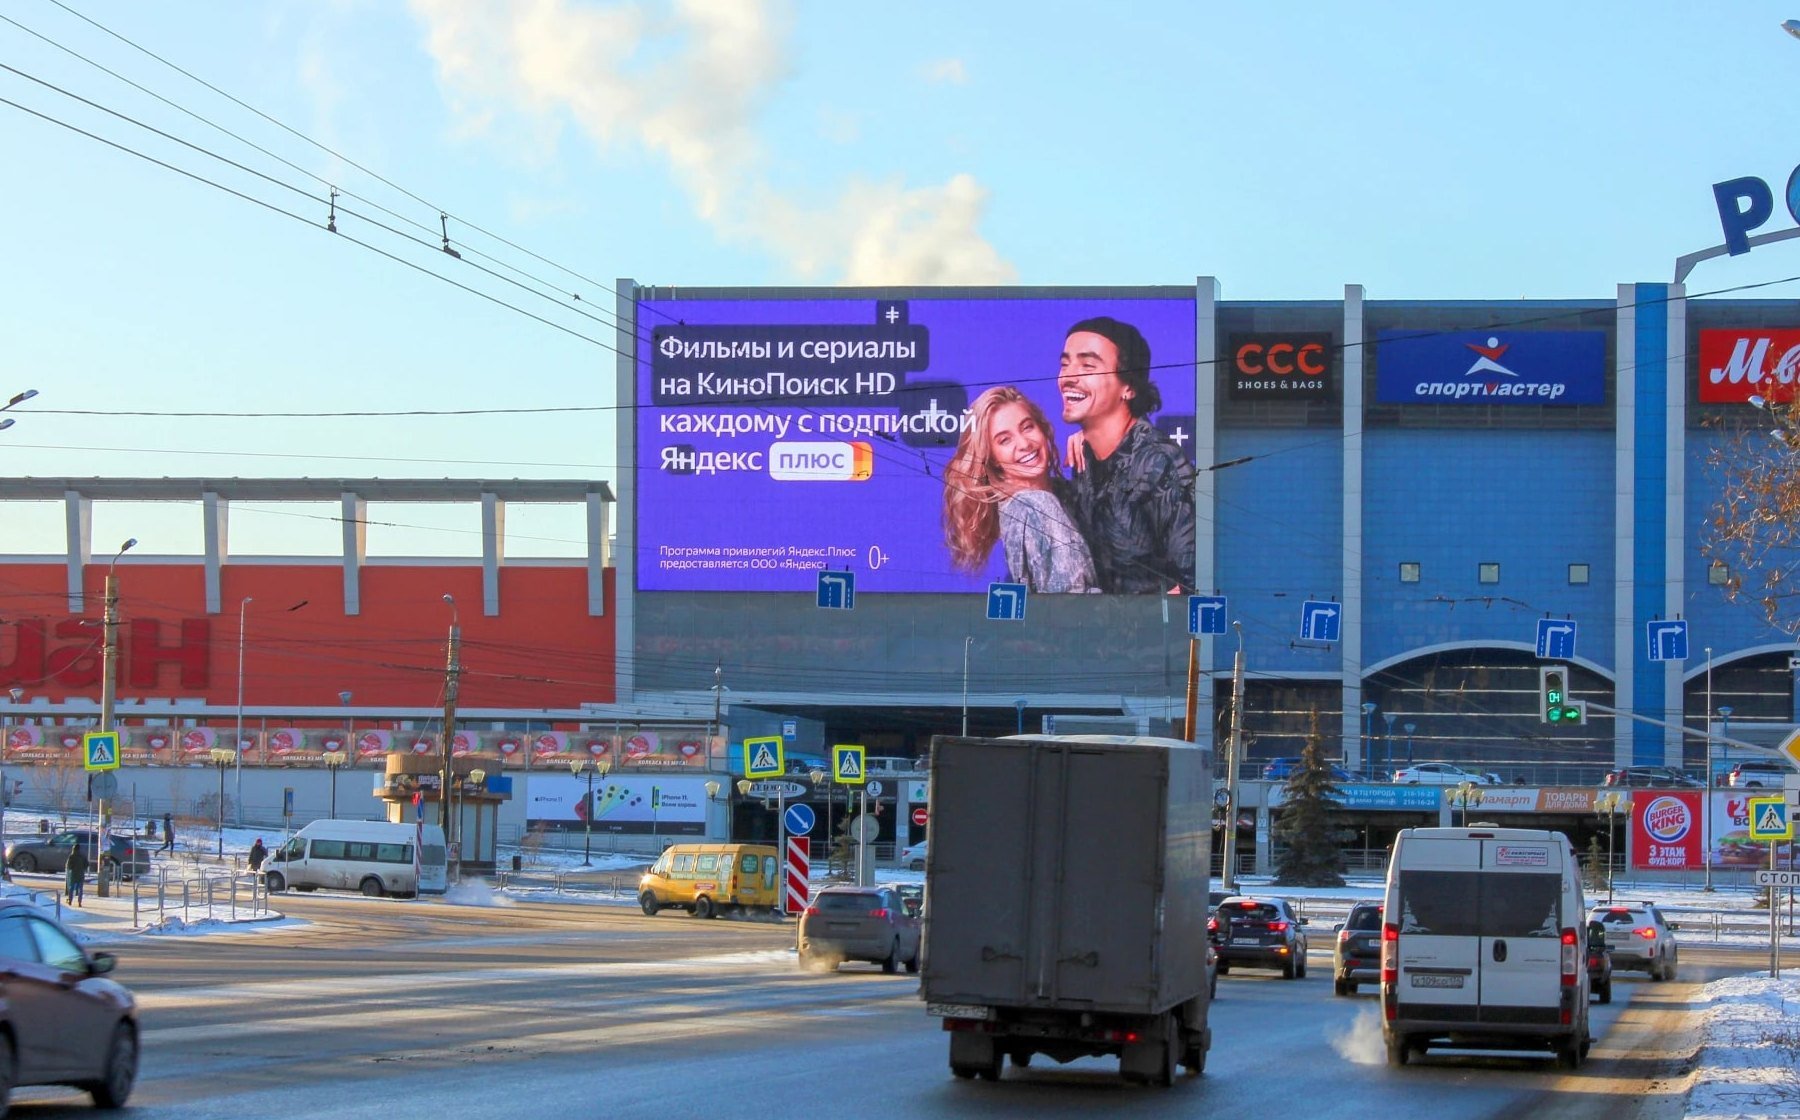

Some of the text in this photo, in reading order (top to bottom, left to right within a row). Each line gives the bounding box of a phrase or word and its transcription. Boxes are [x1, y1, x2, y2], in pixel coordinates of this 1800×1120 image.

[1712, 176, 1800, 257] Р
[660, 336, 916, 363] Фильмы и сериалы
[1236, 343, 1326, 375] CCC
[660, 372, 896, 395] на КиноПоиск HD
[1237, 381, 1323, 389] SHOES & BAGS
[1415, 382, 1565, 399] спортмастер
[660, 409, 977, 438] каждому с подпиской
[660, 446, 845, 475] Яндекс плюс
[659, 545, 890, 570] Программа привилегий Яндекс.Плюс 0+
[659, 559, 749, 569] предоставляется
[751, 559, 777, 568] ООО
[1545, 792, 1588, 801] ТОВАРЫ
[1545, 801, 1588, 809] ДЛЯ ДОМА
[1649, 805, 1684, 821] BURGER
[1650, 813, 1686, 832] KING
[1649, 845, 1686, 857] 3 ЭТАЖ
[1648, 857, 1686, 866] ФУД-КОРТ
[1760, 873, 1800, 884] СТОП
